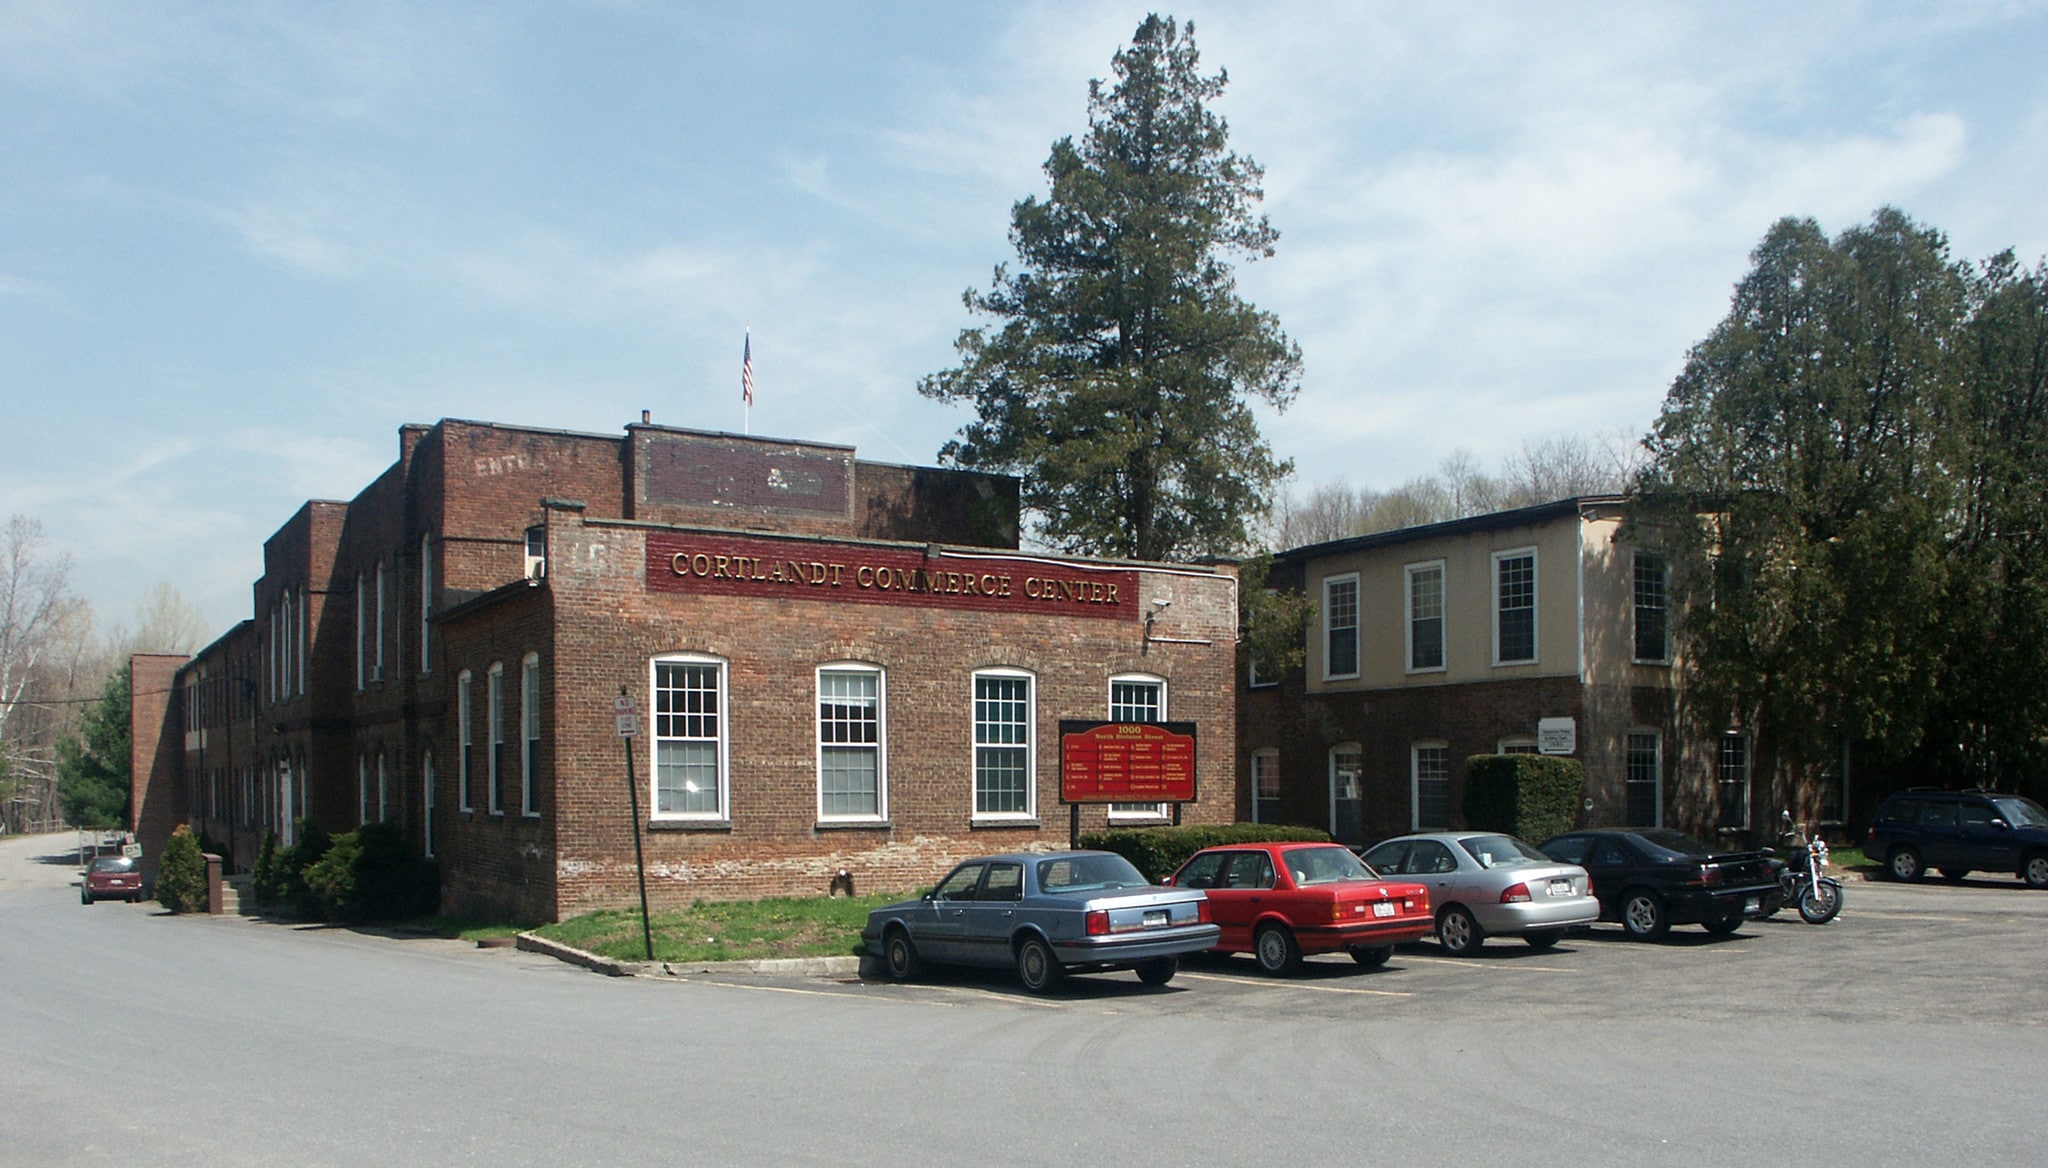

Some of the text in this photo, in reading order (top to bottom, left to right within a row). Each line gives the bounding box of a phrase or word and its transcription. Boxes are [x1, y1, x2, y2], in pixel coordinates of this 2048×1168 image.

[671, 552, 1121, 605] CORTLANDT COMMERCE CENTER
[1118, 725, 1142, 735] 1000
